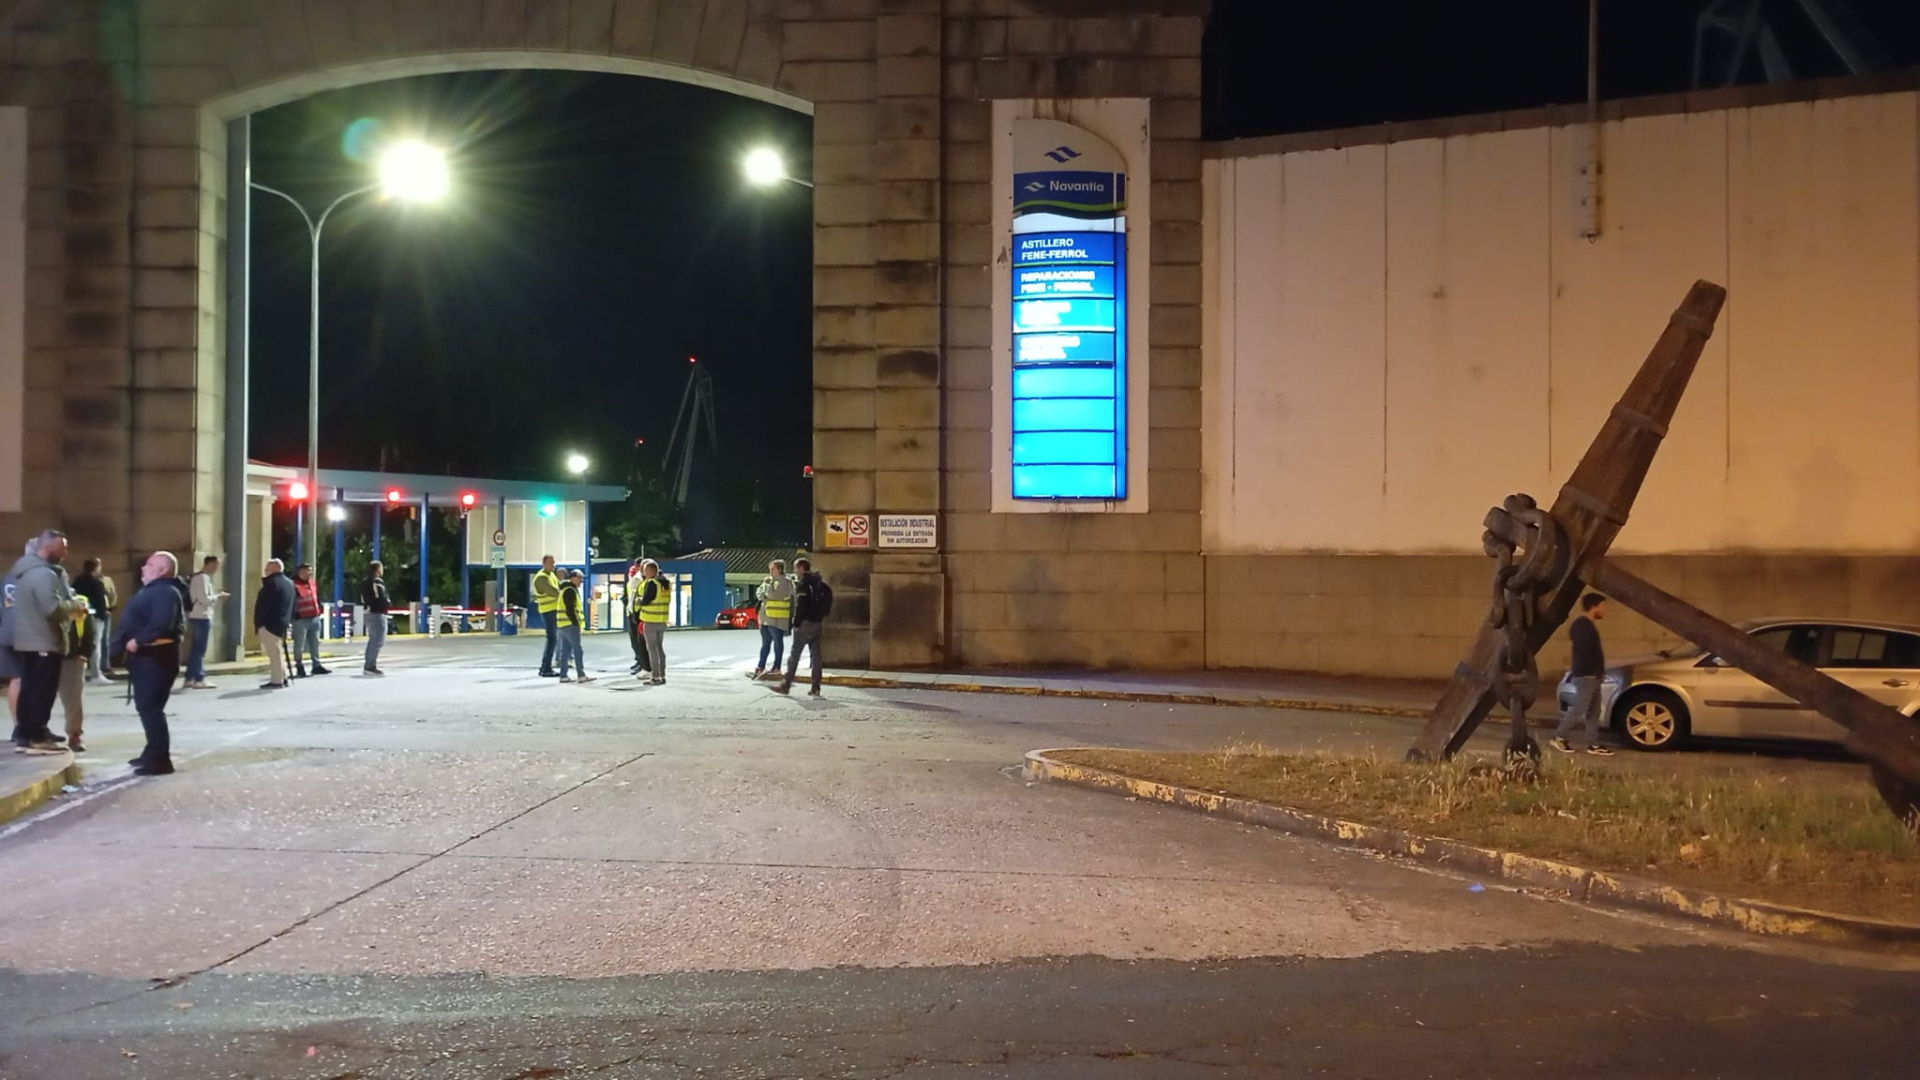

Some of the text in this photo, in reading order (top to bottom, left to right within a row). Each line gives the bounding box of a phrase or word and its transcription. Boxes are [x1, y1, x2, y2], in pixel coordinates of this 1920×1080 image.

[1049, 180, 1104, 192] Navantia
[1021, 238, 1074, 249] ASTILLERO
[1021, 249, 1088, 260] FENE-FERROL
